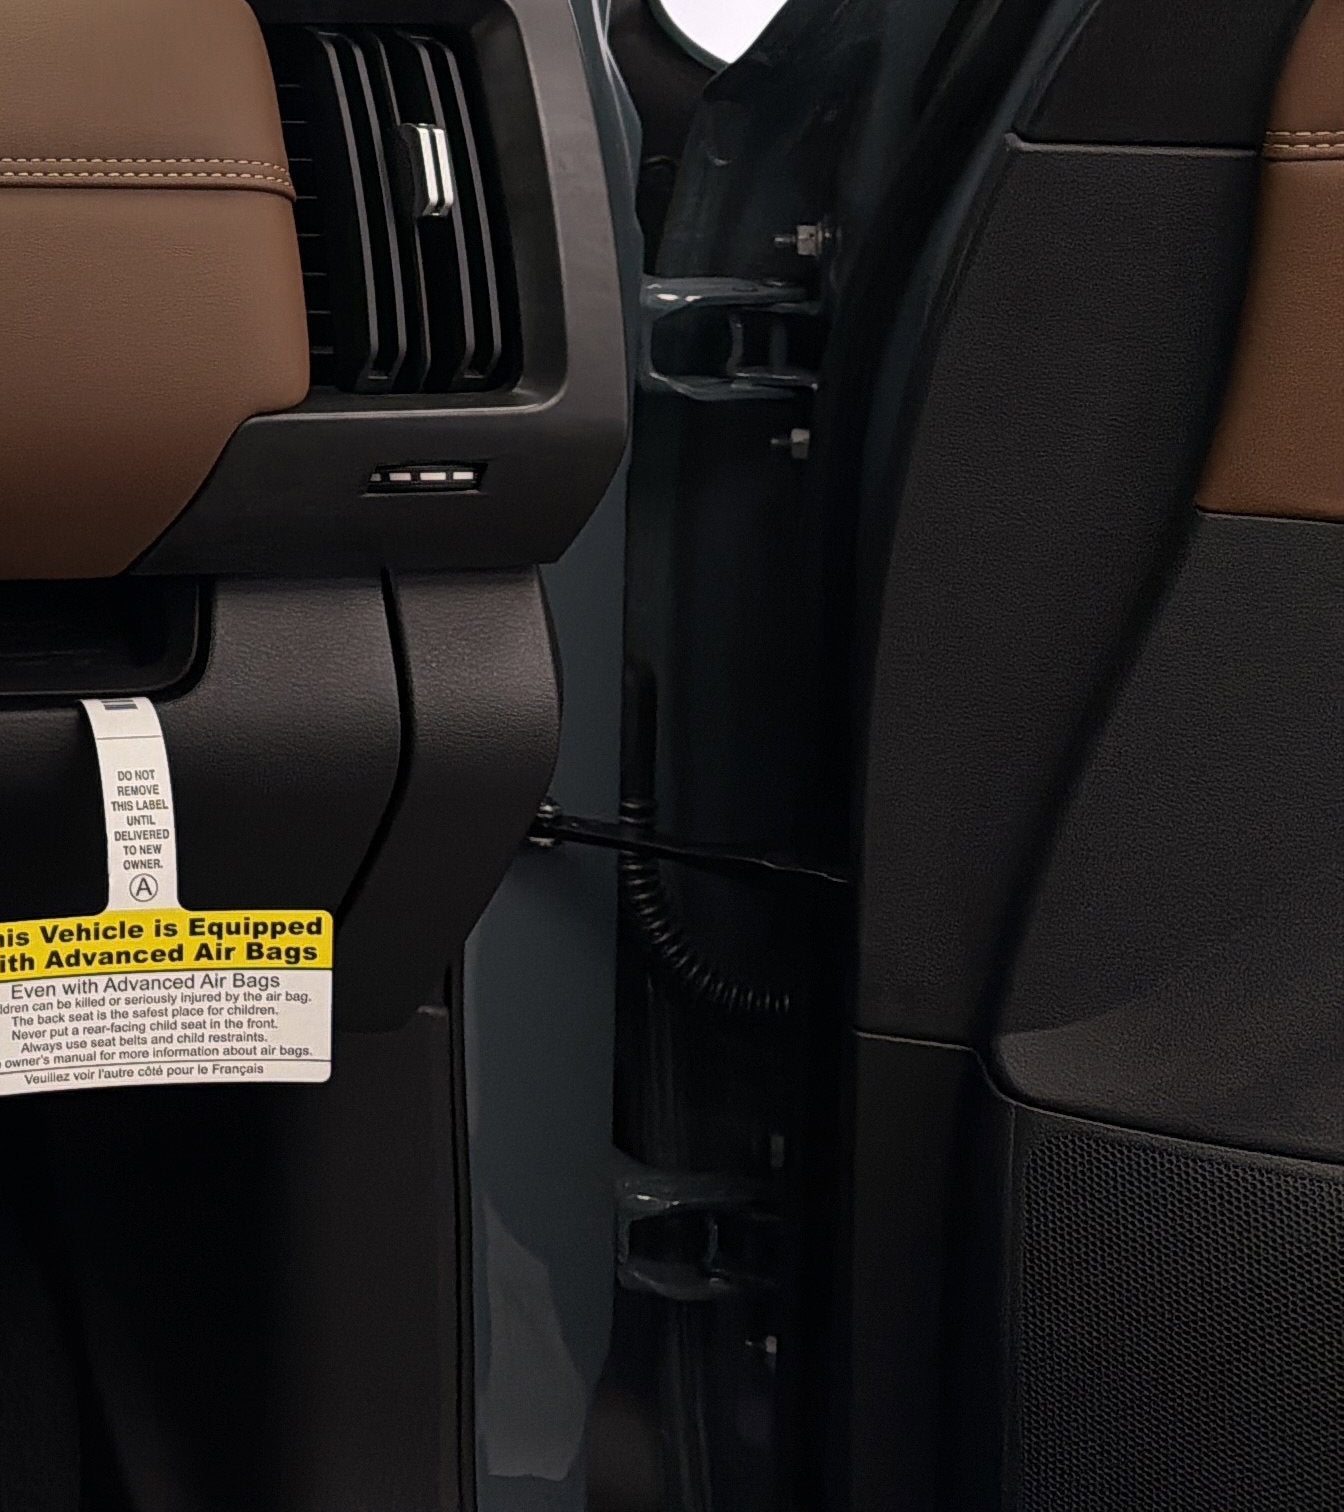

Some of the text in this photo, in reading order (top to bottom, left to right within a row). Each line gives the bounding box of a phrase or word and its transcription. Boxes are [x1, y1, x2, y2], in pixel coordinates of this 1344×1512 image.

[117, 769, 155, 781] DO NOT
[117, 784, 160, 796] REMOVE
[111, 799, 169, 812] THIS LABEL
[127, 815, 156, 826] UNTIL
[114, 829, 169, 841] DELIVERED
[123, 844, 162, 856] TO NEW
[123, 859, 163, 870] OWNER.
[40, 921, 144, 944] Vehicle
[154, 919, 178, 937] is
[189, 917, 323, 939] Equipped
[44, 944, 184, 970] Advanced
[194, 942, 236, 961] Air
[246, 941, 318, 964] Bags
[11, 973, 281, 1000] Even with Advanced Air Bags
[32, 1001, 53, 1012] can
[57, 999, 71, 1009] be
[75, 996, 105, 1007] killed
[109, 996, 122, 1005] or
[124, 991, 177, 1006] seriously
[180, 991, 222, 1004] injured
[225, 991, 240, 1004] by
[243, 991, 262, 1002] the
[266, 991, 282, 1002] air
[285, 991, 312, 1004] bag.
[12, 1005, 279, 1027] The back seat is the safest place for children.
[12, 1018, 278, 1041] Never put a rear-facing child seat in the front.
[21, 1032, 268, 1054] Always use seat belts and child restraints.
[4, 1055, 50, 1068] owner's
[54, 1051, 97, 1065] manual
[100, 1050, 117, 1060] for
[119, 1050, 150, 1060] more
[153, 1045, 219, 1058] information
[223, 1045, 257, 1056] about
[260, 1045, 276, 1055] air
[280, 1044, 312, 1058] bags.
[24, 1063, 264, 1085] Veuillez voir l'autre côté pour le Français
